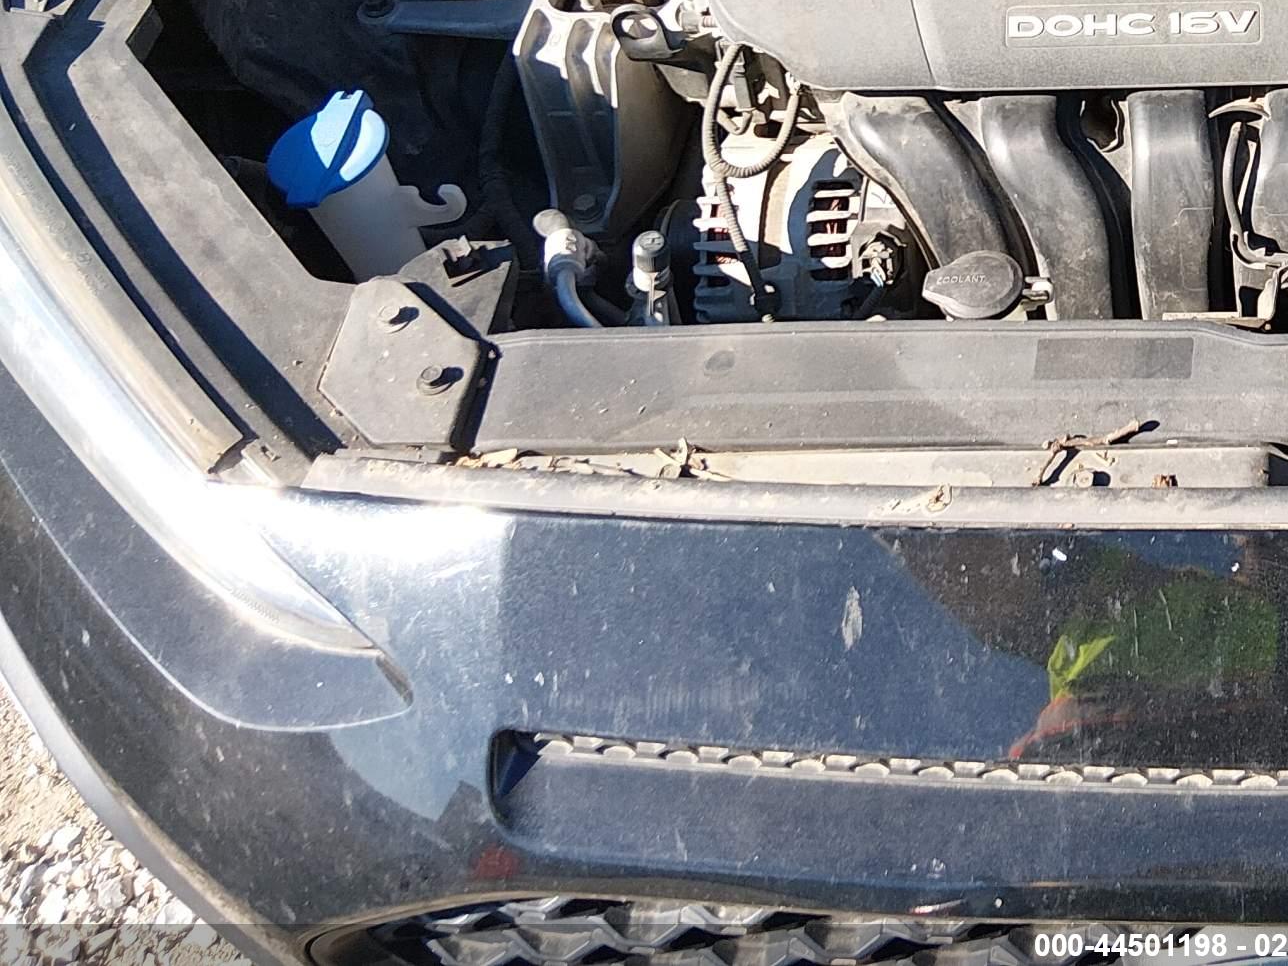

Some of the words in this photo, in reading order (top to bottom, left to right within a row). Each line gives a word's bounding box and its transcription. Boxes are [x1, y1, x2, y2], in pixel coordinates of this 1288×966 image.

[1007, 12, 1156, 38] DOHC
[1168, 9, 1258, 35] 16V
[936, 274, 986, 285] COOLANT
